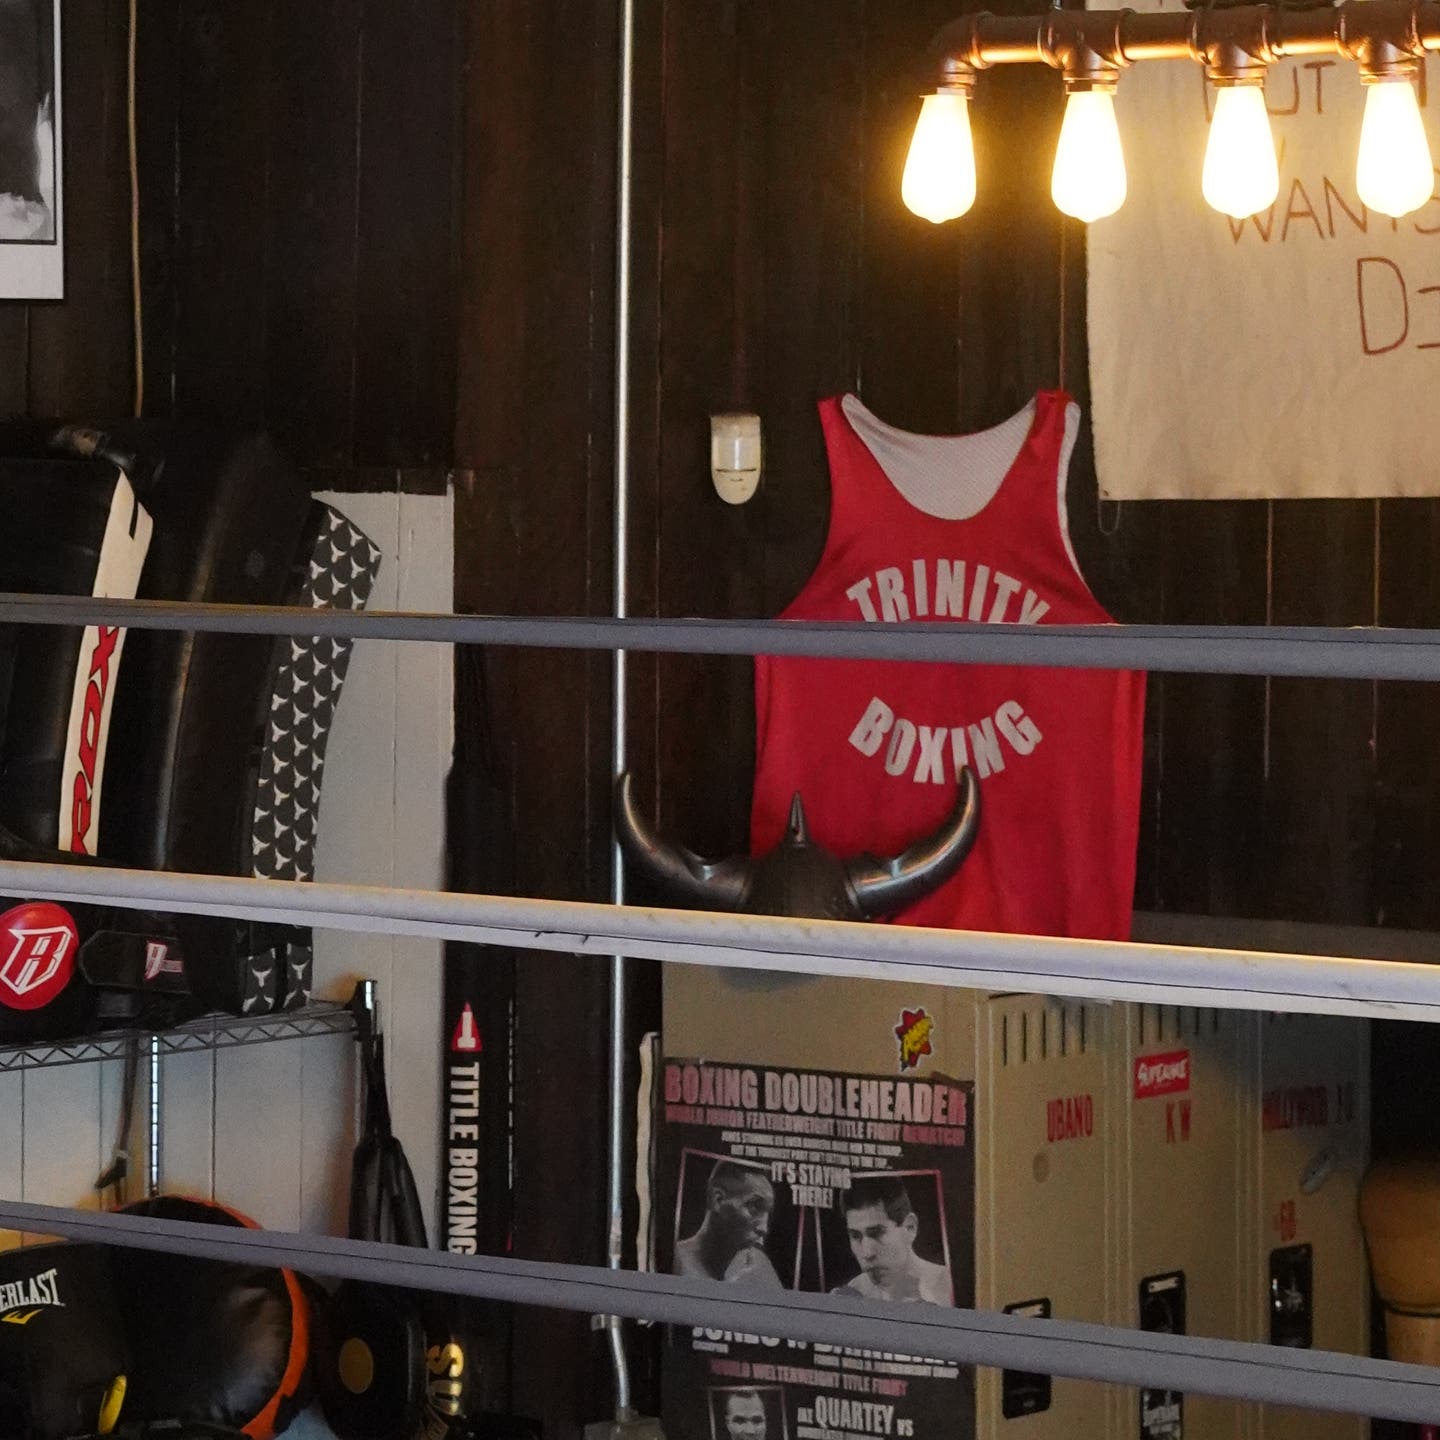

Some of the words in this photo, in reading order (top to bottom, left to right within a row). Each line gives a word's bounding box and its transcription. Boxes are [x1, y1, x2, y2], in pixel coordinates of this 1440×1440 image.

[1203, 56, 1337, 123] UT
[846, 558, 1051, 626] TRINITY
[847, 695, 1044, 785] BOXING
[449, 1061, 480, 1142] TITLE
[665, 1063, 759, 1109] BOXING
[764, 1070, 967, 1125] DOUBLEHEADER
[836, 1118, 865, 1140] TITLE
[447, 1146, 480, 1258] BOXING
[771, 1161, 797, 1185] IT'S
[798, 1163, 853, 1190] STAYING
[815, 1394, 895, 1436] QUARTEY
